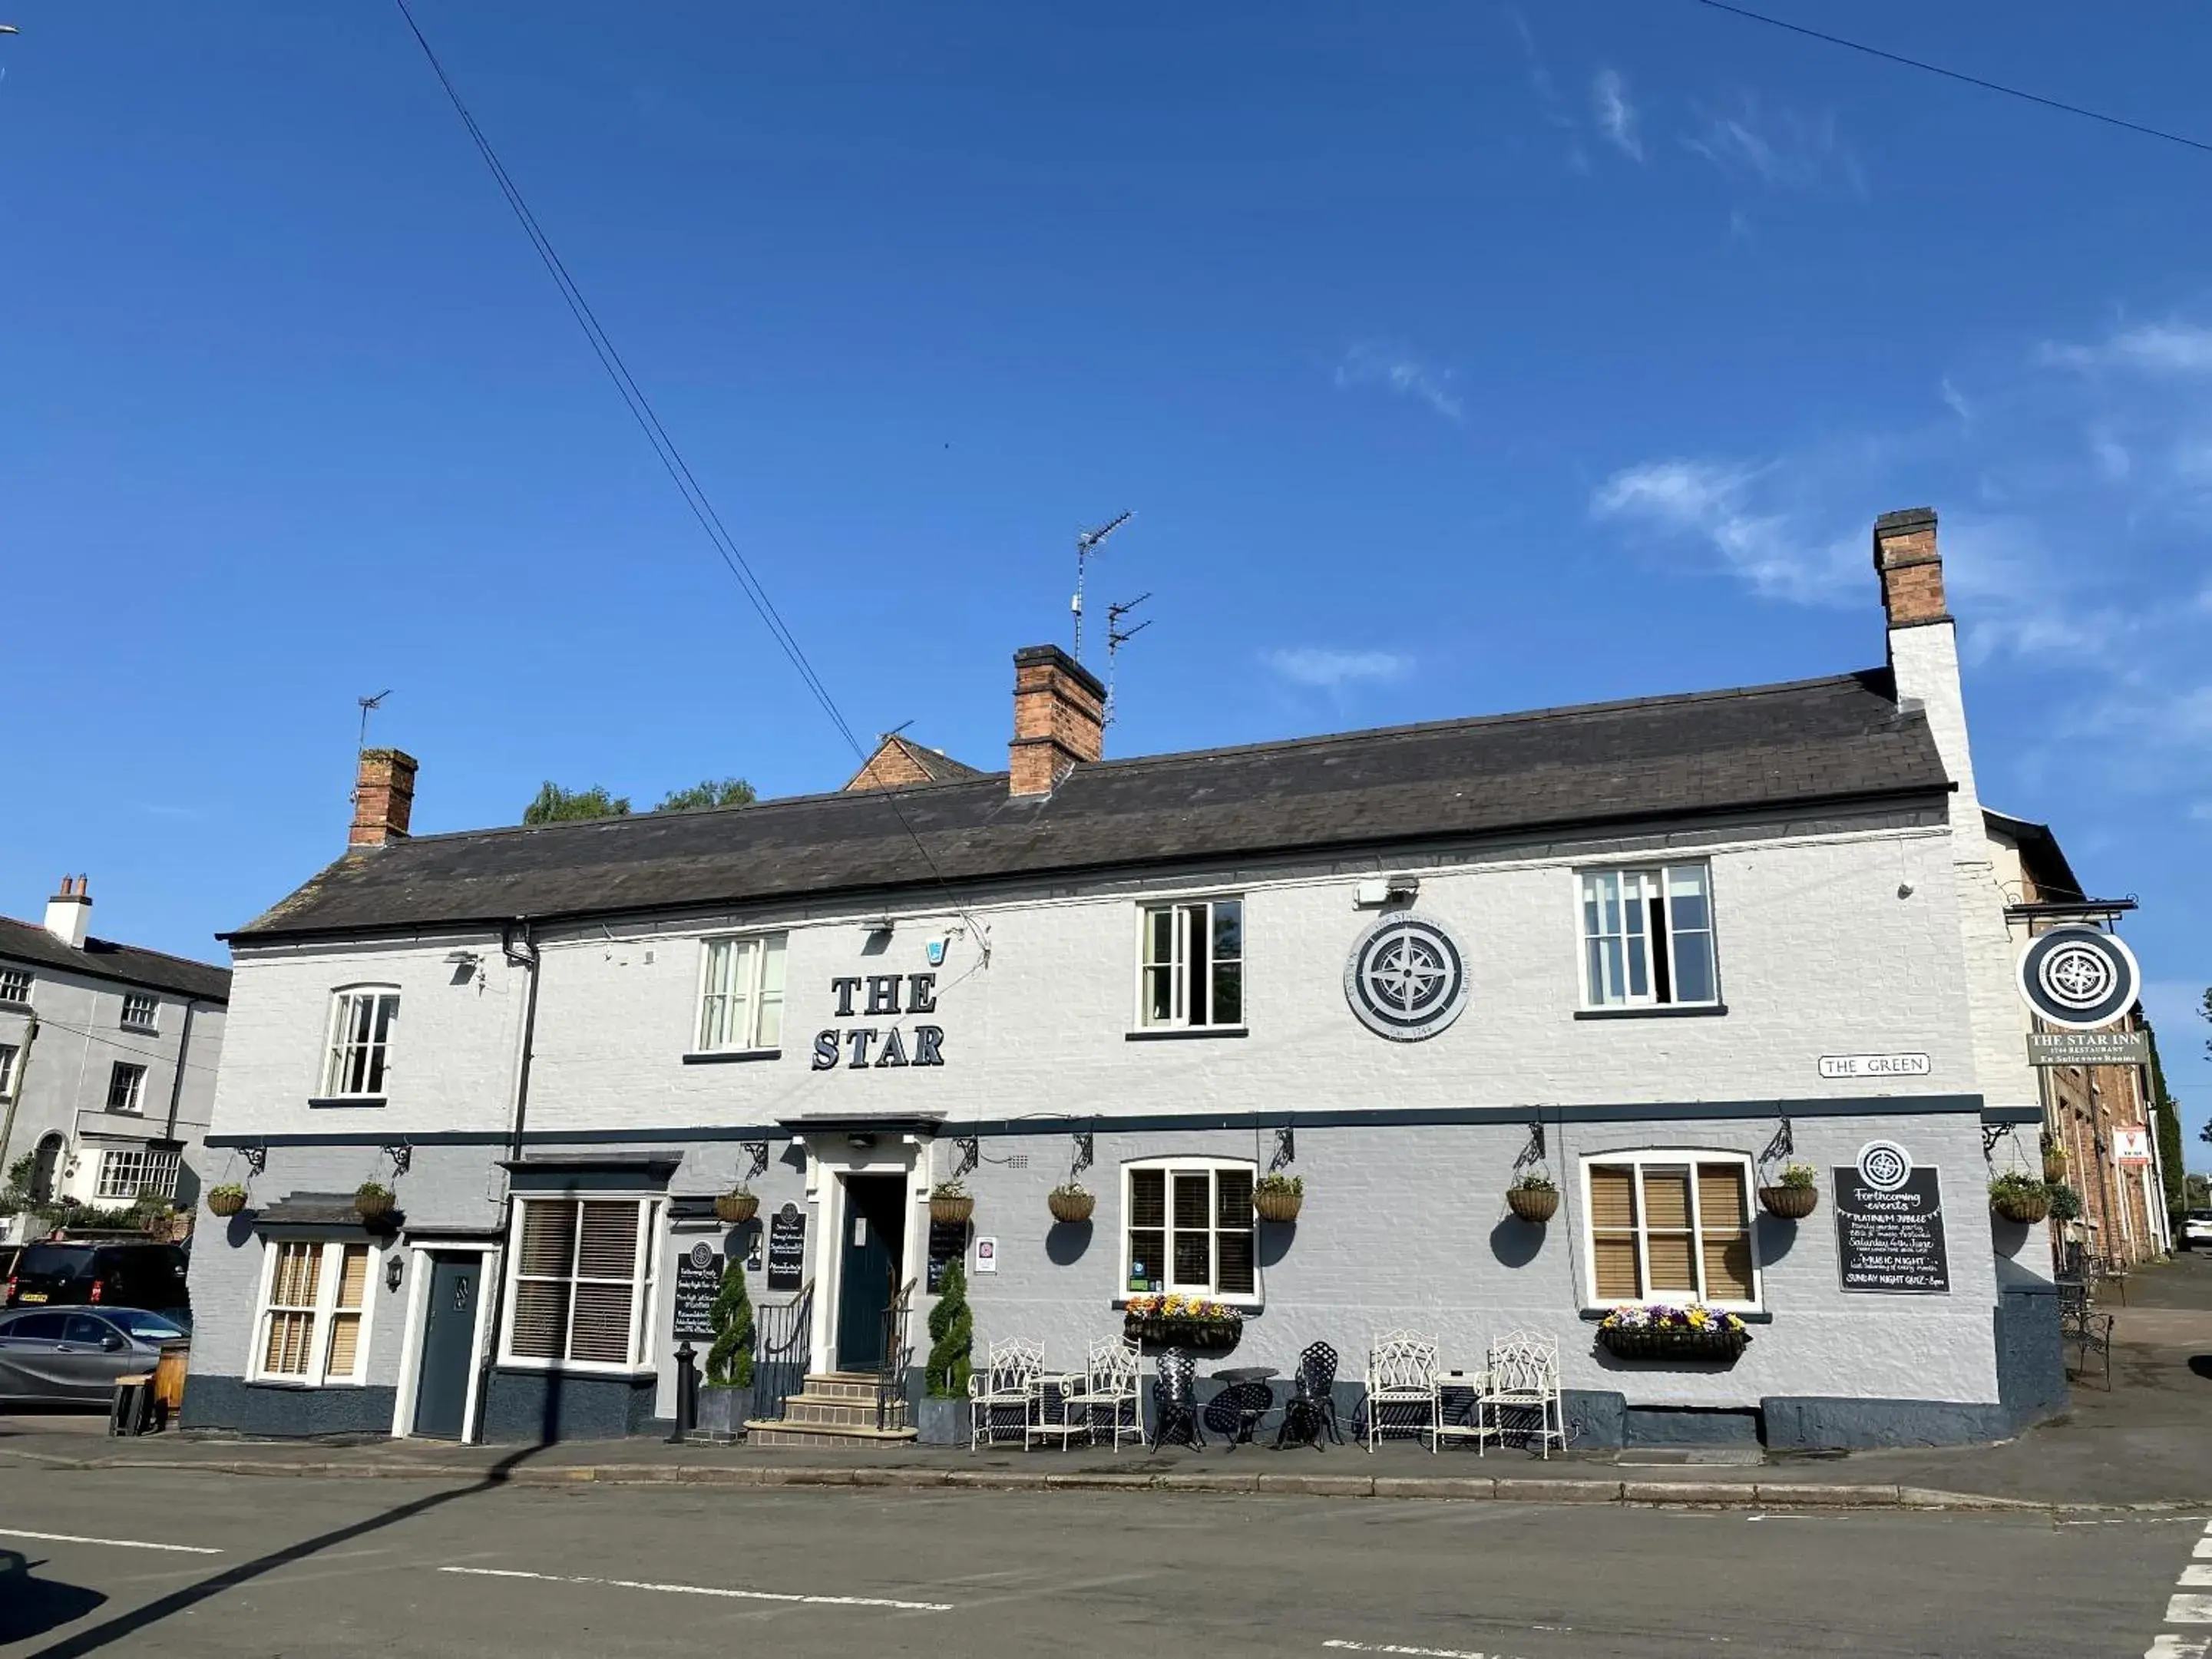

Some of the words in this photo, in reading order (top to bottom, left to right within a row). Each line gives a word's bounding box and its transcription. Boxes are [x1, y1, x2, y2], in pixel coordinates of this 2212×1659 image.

[832, 973, 937, 1016] THE
[2031, 1034, 2062, 1046] THE
[2067, 1034, 2108, 1045] STAR
[2113, 1033, 2141, 1045] INN
[812, 1025, 944, 1071] STAR
[1825, 1059, 1857, 1073] THE
[1867, 1058, 1923, 1072] GREEN
[1853, 1188, 1921, 1207] Forthcoming
[1864, 1200, 1909, 1211] events
[1849, 1237, 1889, 1248] Saturday
[1862, 1256, 1893, 1265] MUSIC
[1894, 1257, 1924, 1265] NIGHT
[1846, 1274, 1878, 1283] SUNDAY
[1880, 1274, 1904, 1285] NIGHT
